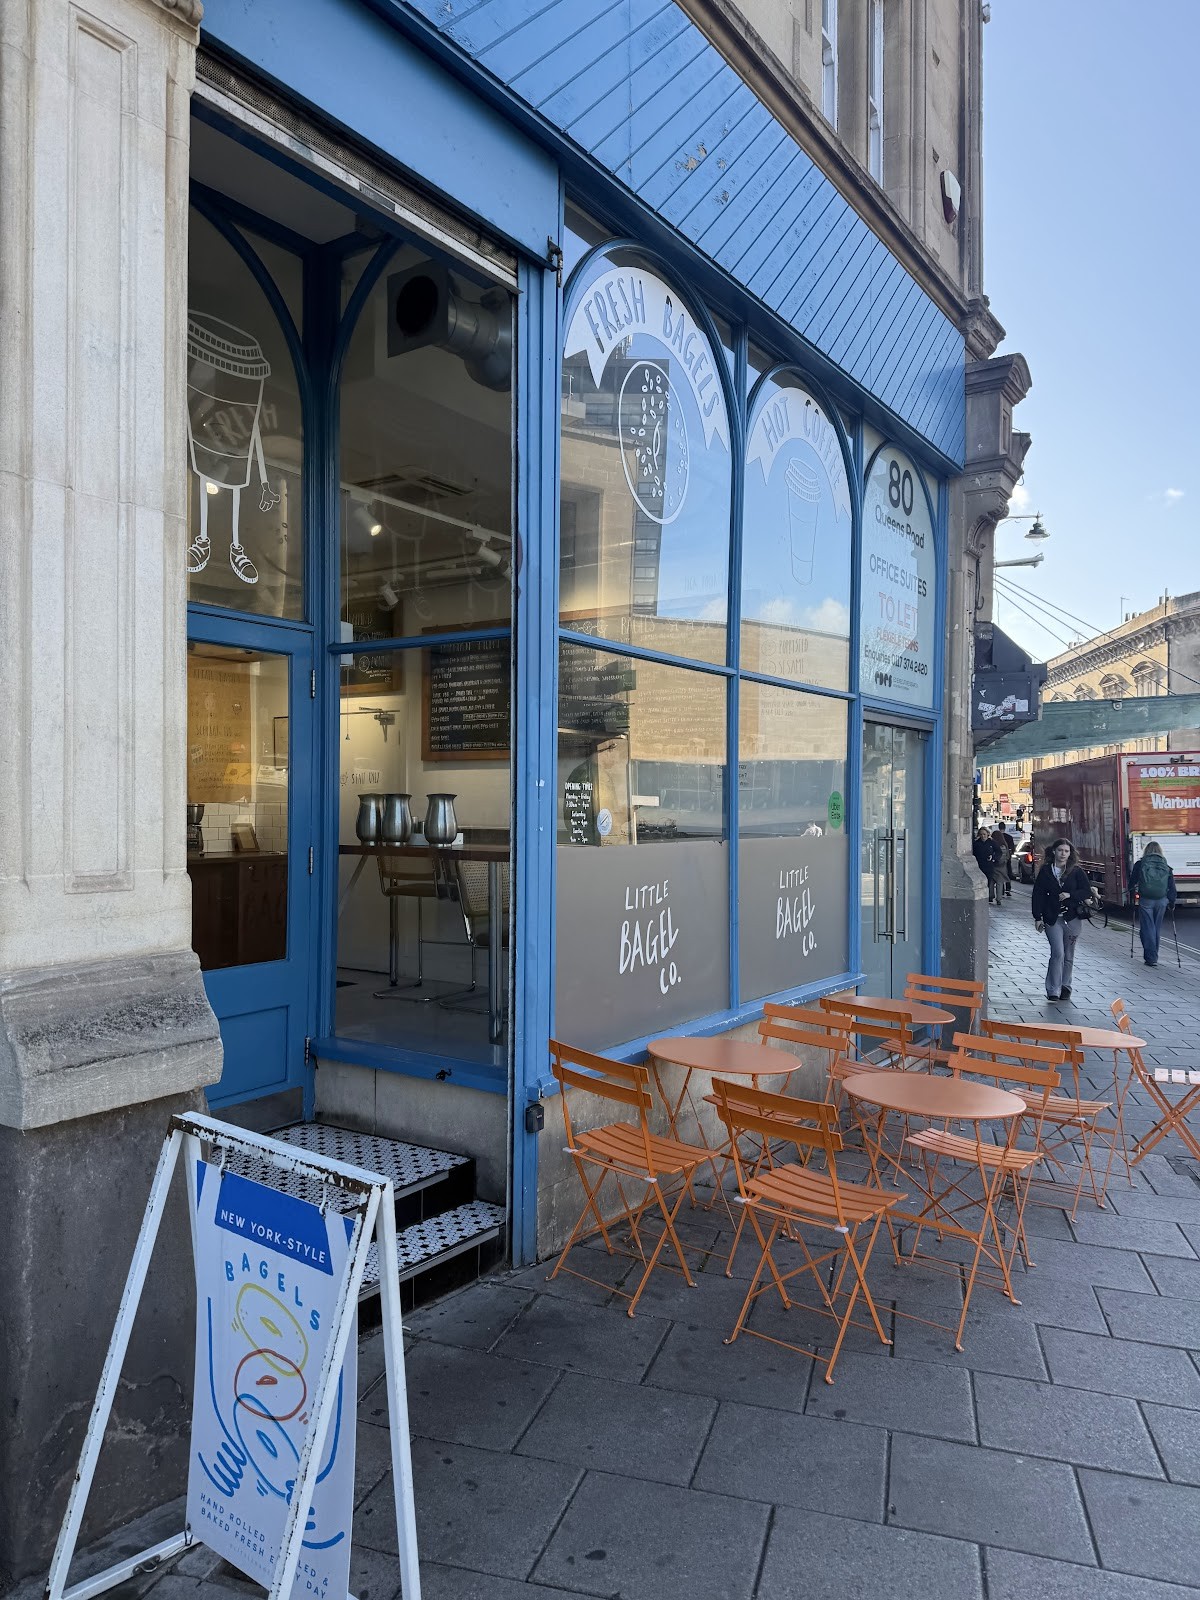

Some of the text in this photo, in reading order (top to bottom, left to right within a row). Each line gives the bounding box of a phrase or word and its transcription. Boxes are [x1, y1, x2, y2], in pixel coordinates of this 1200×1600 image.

[584, 275, 720, 417] FRESH BAGELS
[761, 396, 844, 490] HOT COFFEE
[888, 460, 914, 516] 80
[875, 504, 925, 549] Queens Road
[870, 553, 927, 597] OFFICE SUITES
[879, 592, 919, 632] TO LET
[864, 644, 891, 665] Enquiries
[1140, 766, 1176, 778] 100%
[625, 879, 669, 911] LITTLE
[779, 865, 809, 889] LITTLE
[776, 887, 816, 940] BAGEL
[619, 907, 679, 975] BAGEL
[802, 931, 817, 957] CO.
[659, 961, 682, 995] CO.
[221, 1208, 326, 1264] NEW YORK-STYLE
[224, 1252, 320, 1331] BAGELS
[200, 1492, 224, 1514] HAND
[322, 1577, 328, 1587] &
[201, 1507, 326, 1599] BAKED FRESH DAY
